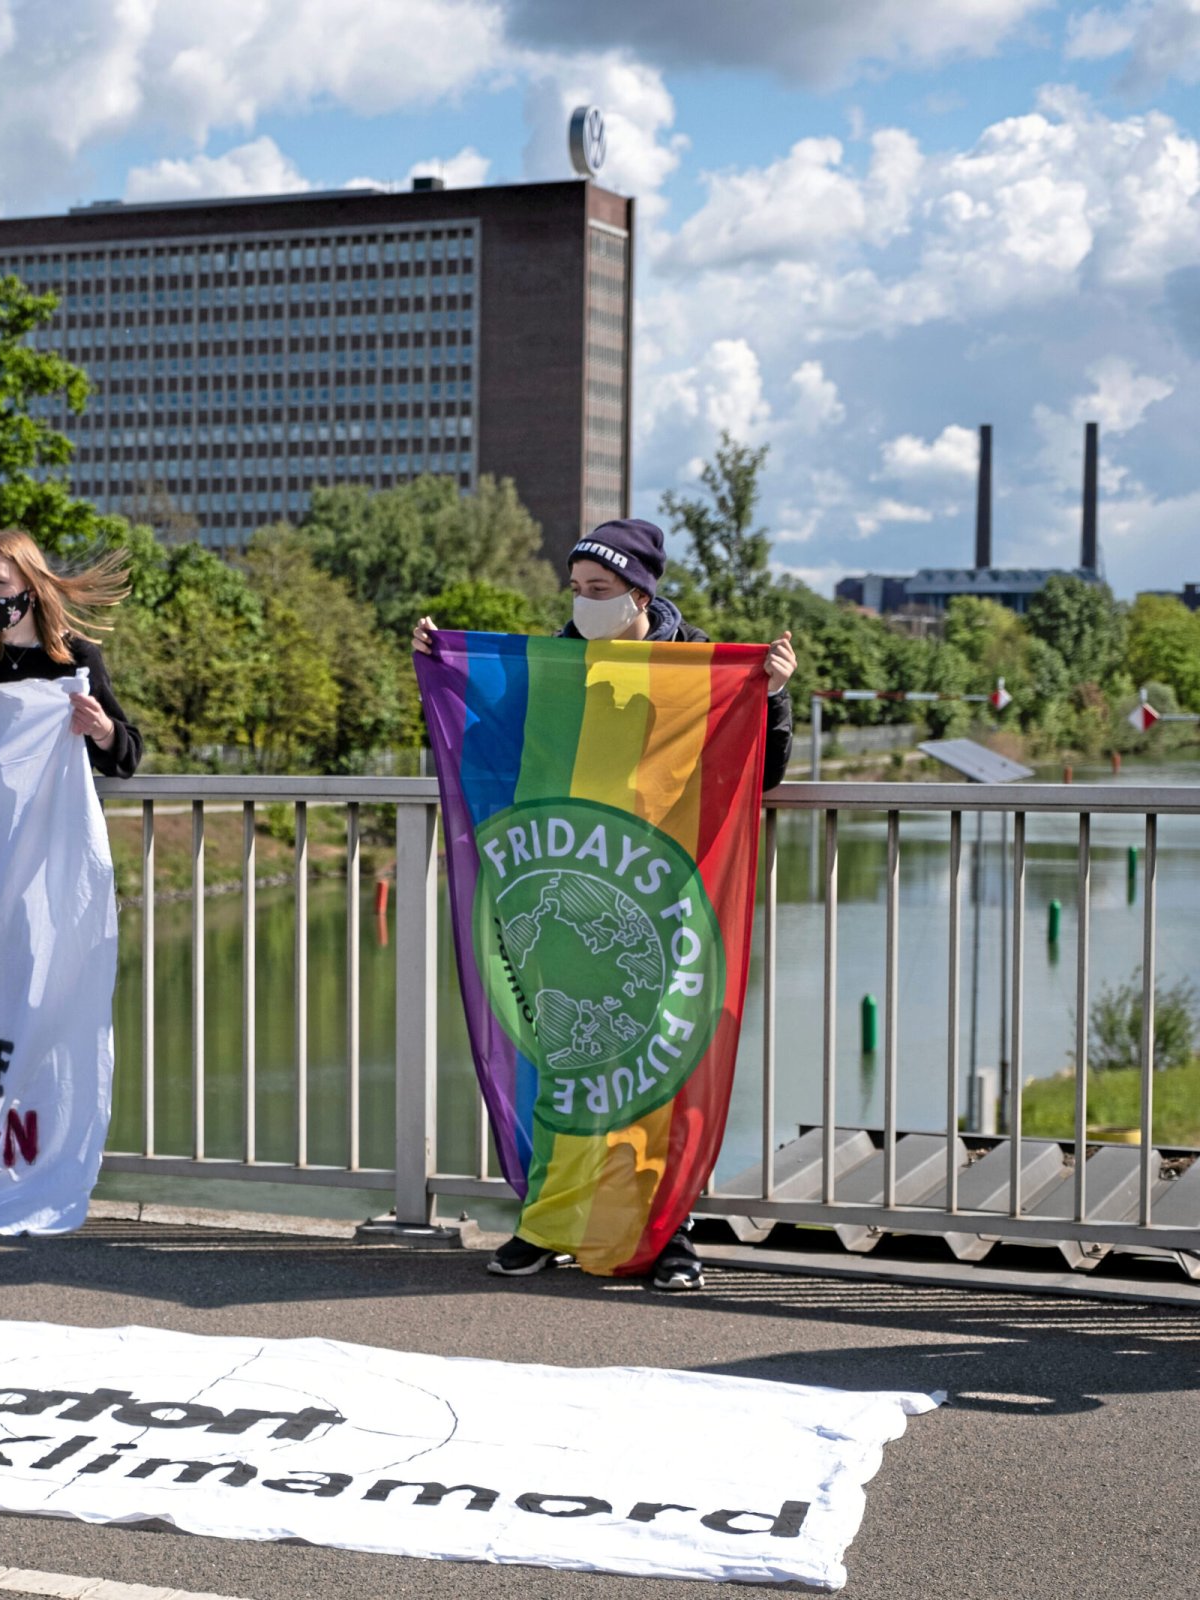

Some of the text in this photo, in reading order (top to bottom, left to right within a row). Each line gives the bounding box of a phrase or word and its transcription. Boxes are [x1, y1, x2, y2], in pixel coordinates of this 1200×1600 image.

[483, 818, 704, 1115] FRIDAYS FOR FUTURE
